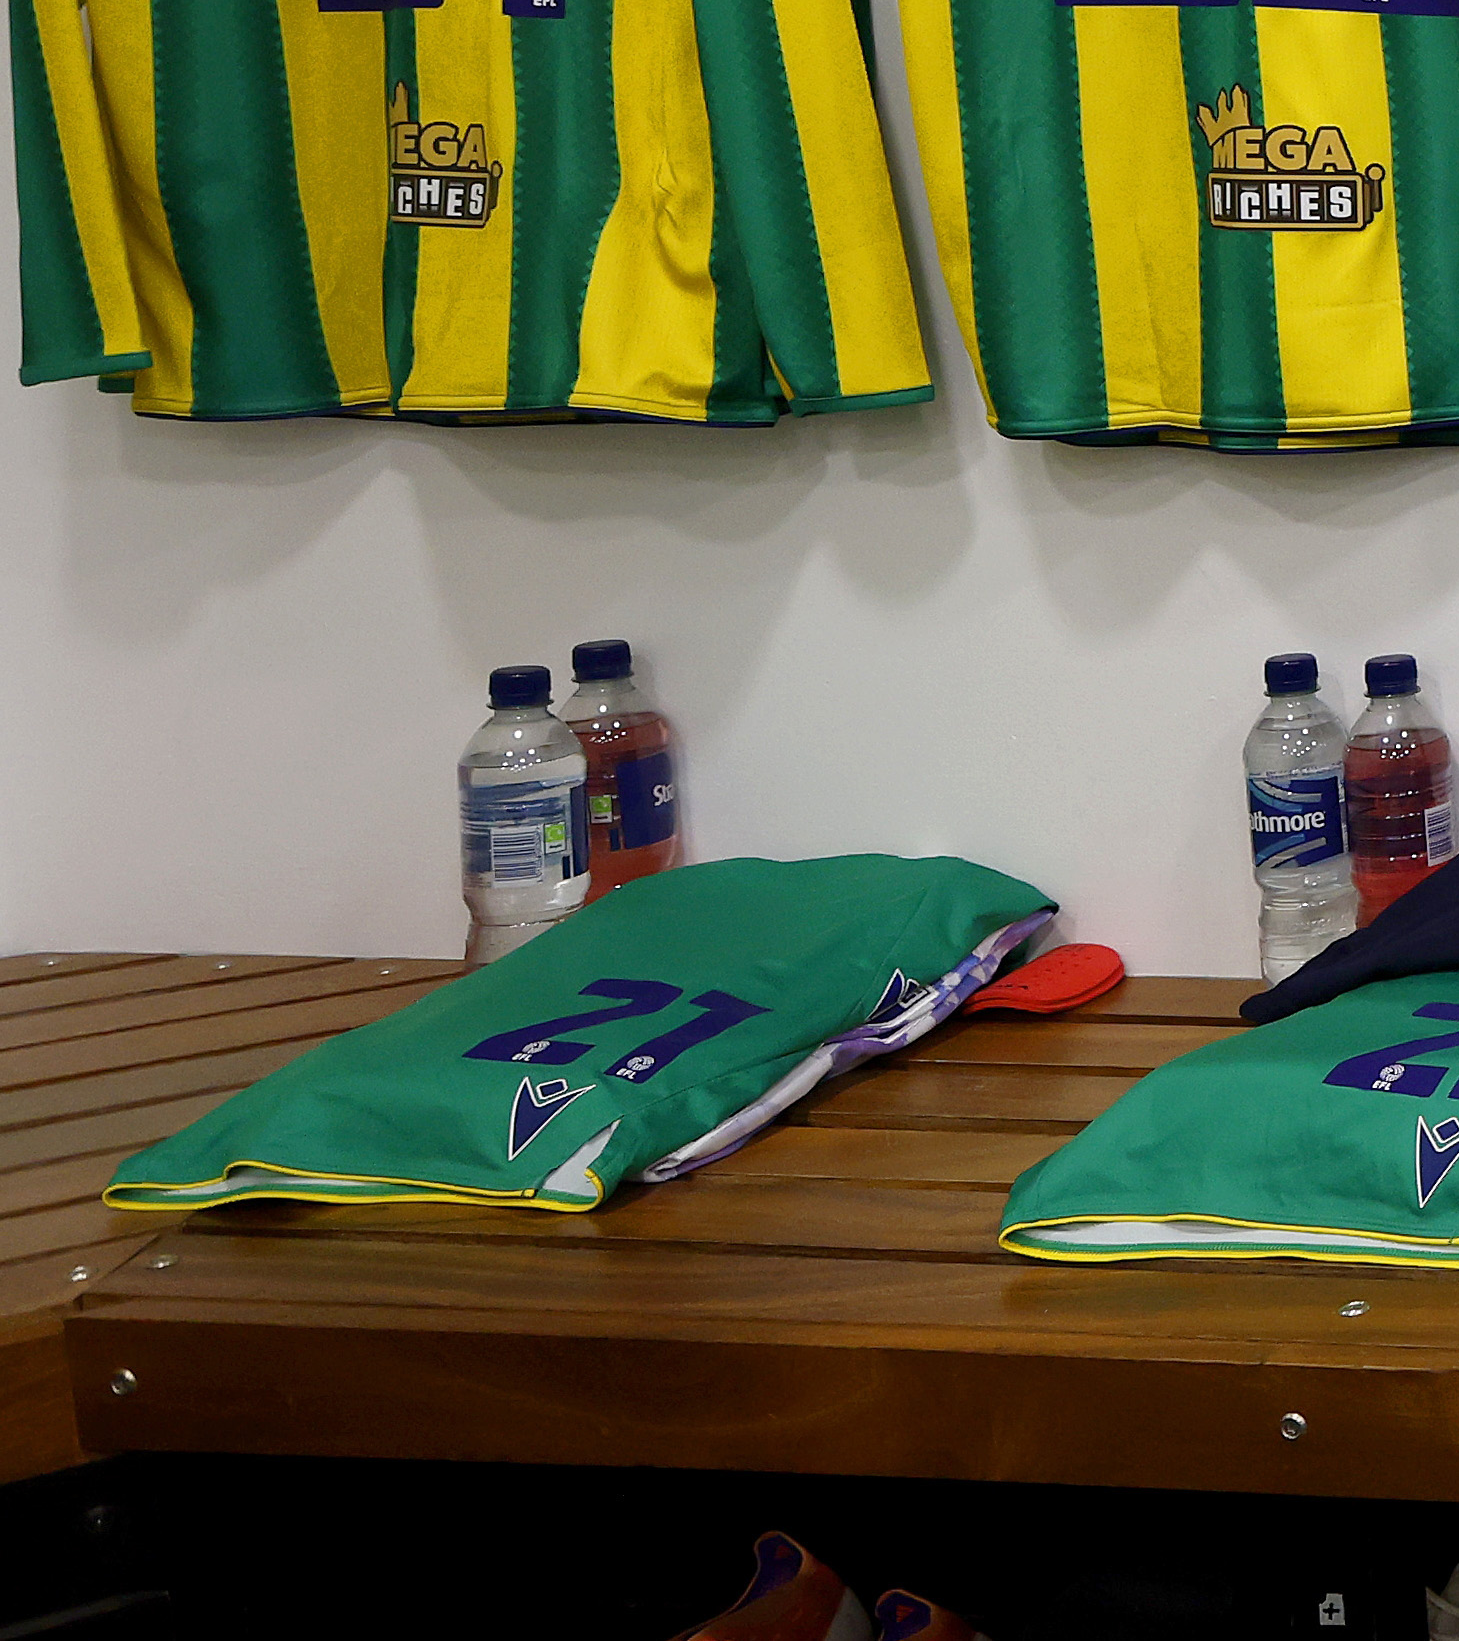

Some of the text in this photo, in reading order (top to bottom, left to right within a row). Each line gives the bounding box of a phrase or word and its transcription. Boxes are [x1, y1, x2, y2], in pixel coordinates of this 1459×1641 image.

[391, 122, 488, 169] EGA
[1212, 127, 1353, 173] MEGA
[392, 177, 486, 217] CHES
[1214, 181, 1352, 221] RICHES
[462, 977, 772, 1083] 21
[616, 1067, 637, 1080] EFL
[1372, 1080, 1391, 1090] EFL
